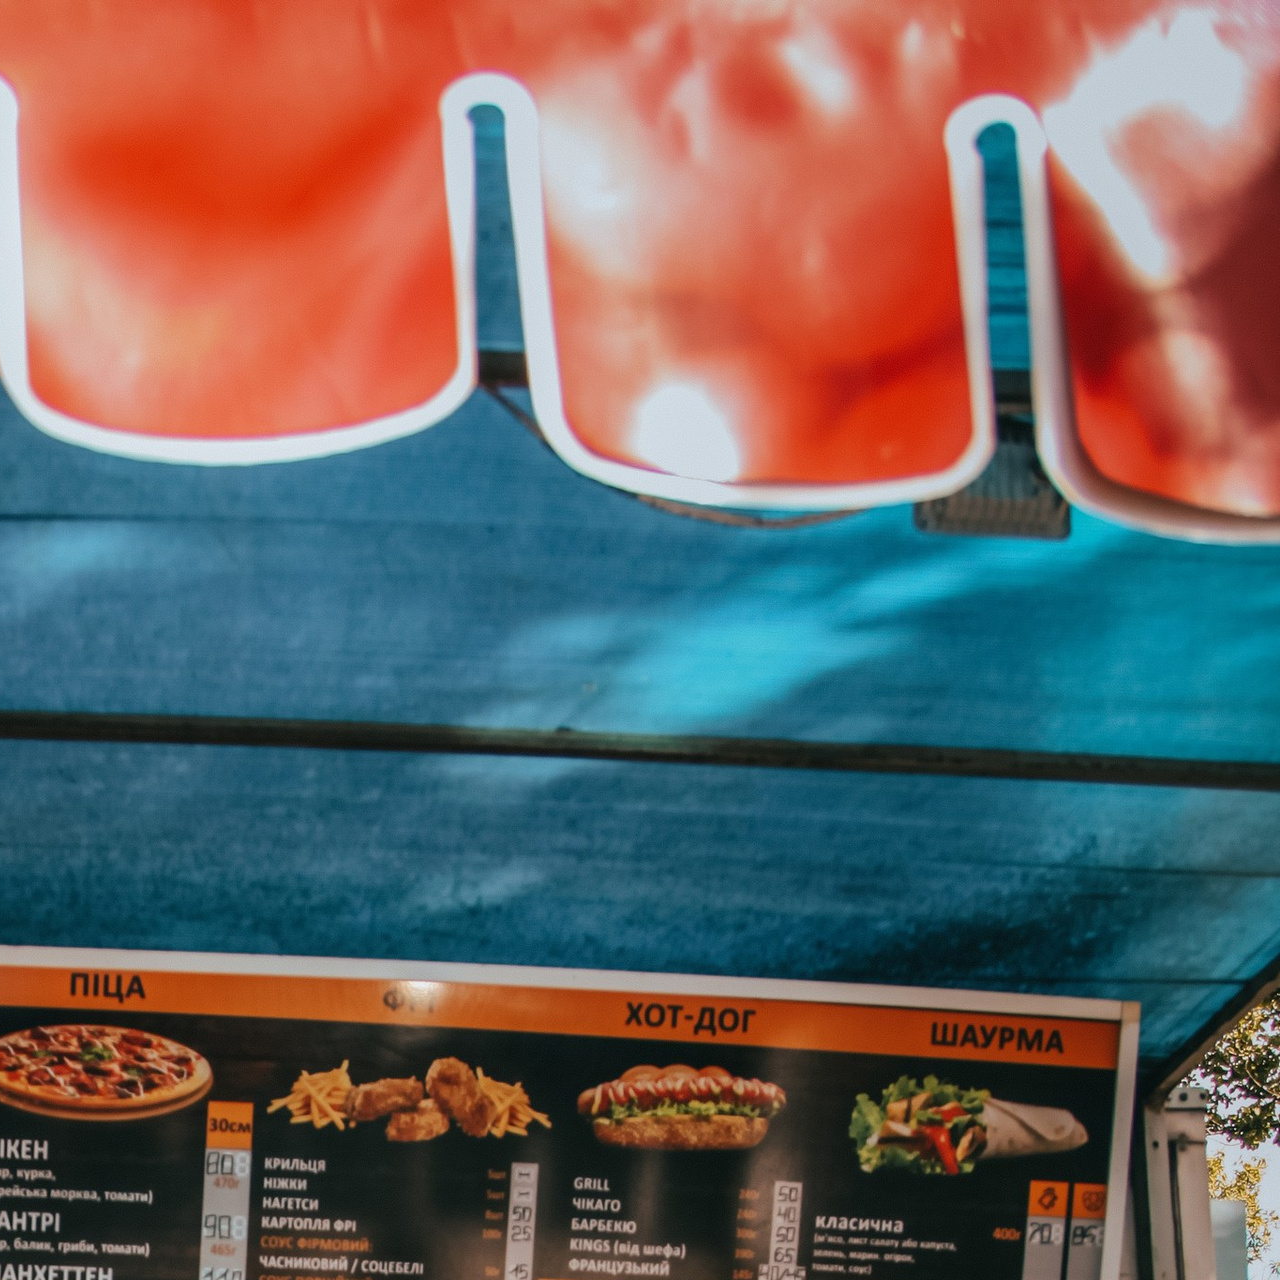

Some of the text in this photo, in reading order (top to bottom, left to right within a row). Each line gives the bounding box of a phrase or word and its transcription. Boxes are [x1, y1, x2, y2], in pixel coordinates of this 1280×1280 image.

[70, 972, 146, 1004] ПІЦА
[625, 1002, 756, 1036] ХОТ-ДОГ
[931, 1022, 1064, 1054] ШАУРМА
[209, 1118, 251, 1133] 30см
[265, 1157, 326, 1173] КРИЛЬЦЯ
[263, 1177, 307, 1191] НІЖКИ
[574, 1178, 610, 1192] GRILL
[778, 1186, 798, 1202] 50
[262, 1196, 319, 1211] НАГЕТСИ
[573, 1198, 621, 1212] ЧІКАГО
[261, 1216, 357, 1232] КАРТОПЛЯ ФРІ
[571, 1218, 636, 1234] БАРБЕКЮ
[815, 1215, 904, 1234] класична
[992, 1228, 1021, 1240] 400г
[260, 1236, 293, 1249] СОУС
[570, 1239, 686, 1259] KINGS (від шефа)
[259, 1254, 424, 1276] ЧАСНИКОВИЙ СОЦЕБЕЛІ
[569, 1259, 670, 1276] ФРАНЦУЗЬКИЙ
